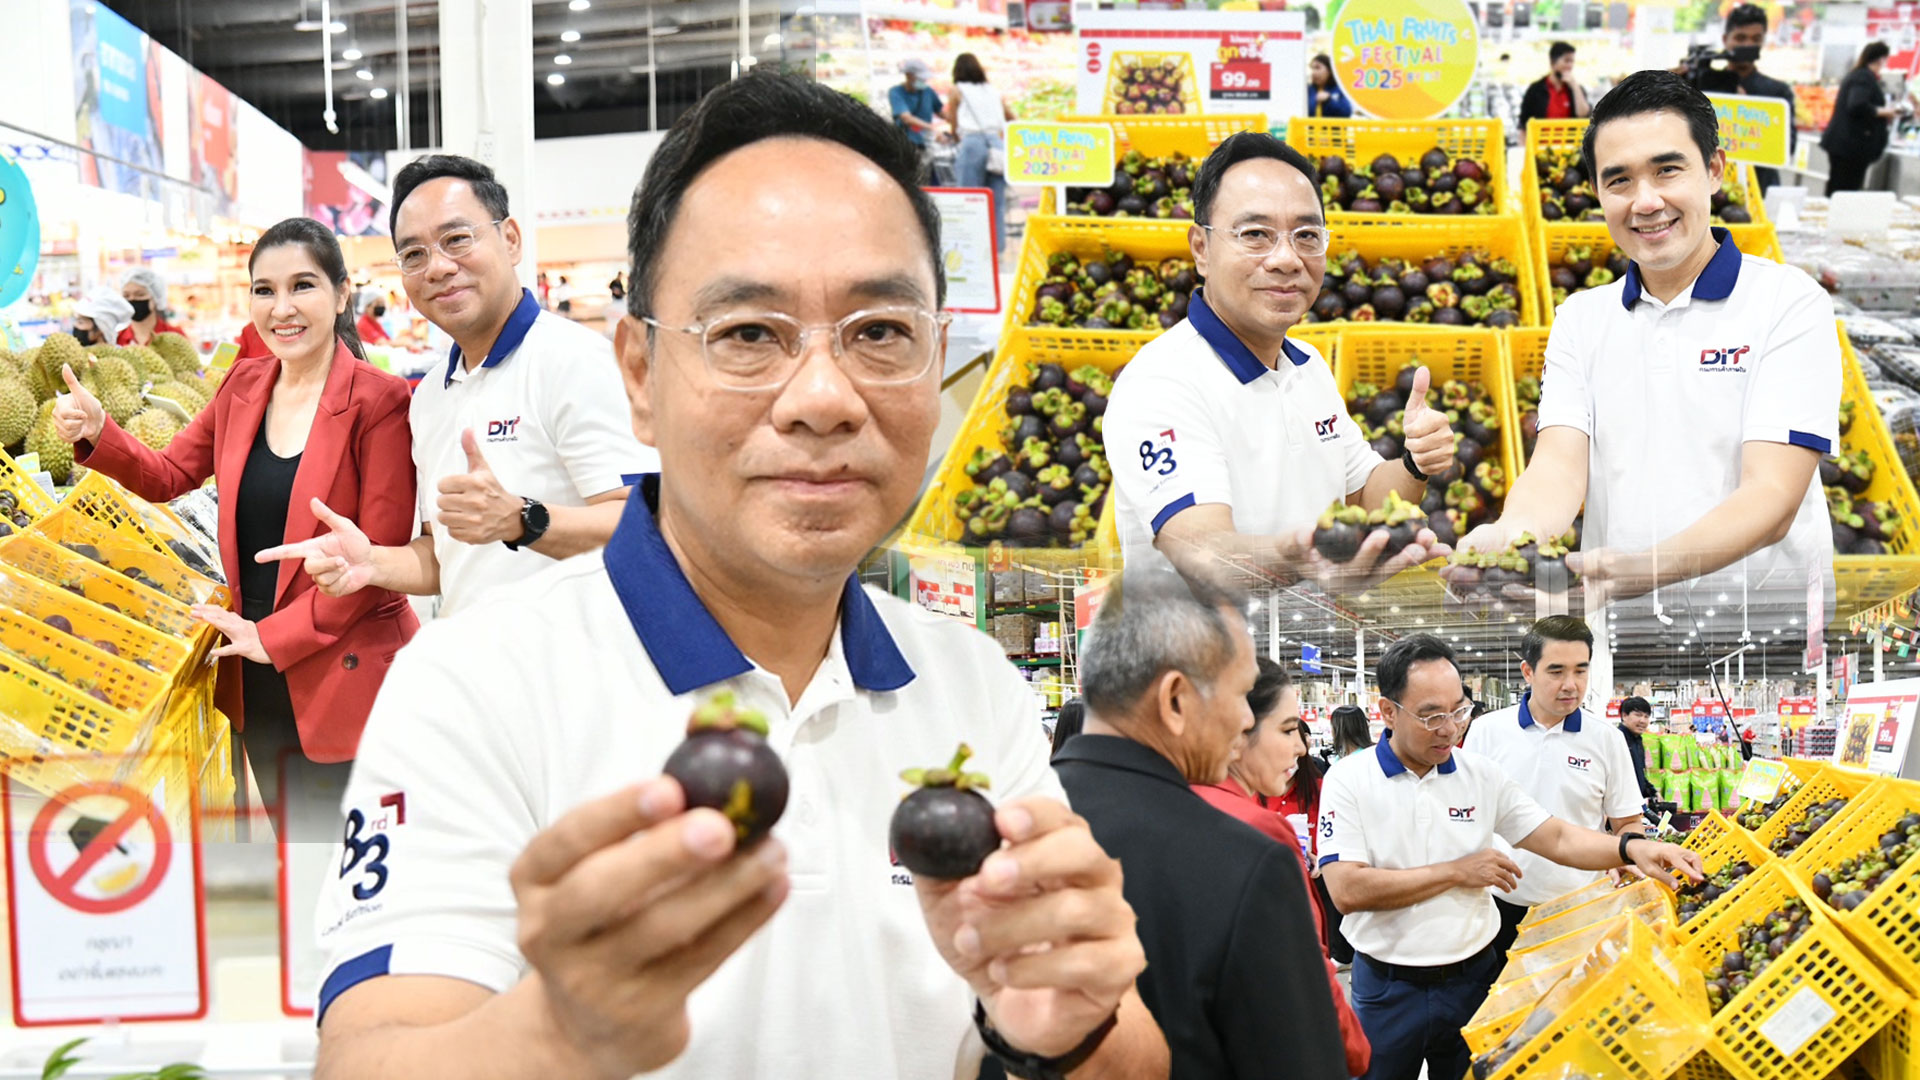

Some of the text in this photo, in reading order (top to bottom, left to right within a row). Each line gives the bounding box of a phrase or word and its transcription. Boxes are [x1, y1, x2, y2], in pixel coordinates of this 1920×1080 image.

[1344, 17, 1457, 45] THAI FRUITS
[1361, 46, 1442, 67] FESTIVAL
[1353, 68, 1403, 89] 2025
[1017, 129, 1052, 147] THAI
[1030, 147, 1085, 162] FESTIVAL
[1023, 161, 1058, 175] 2025
[1140, 440, 1177, 475] 83
[371, 812, 388, 831] rd
